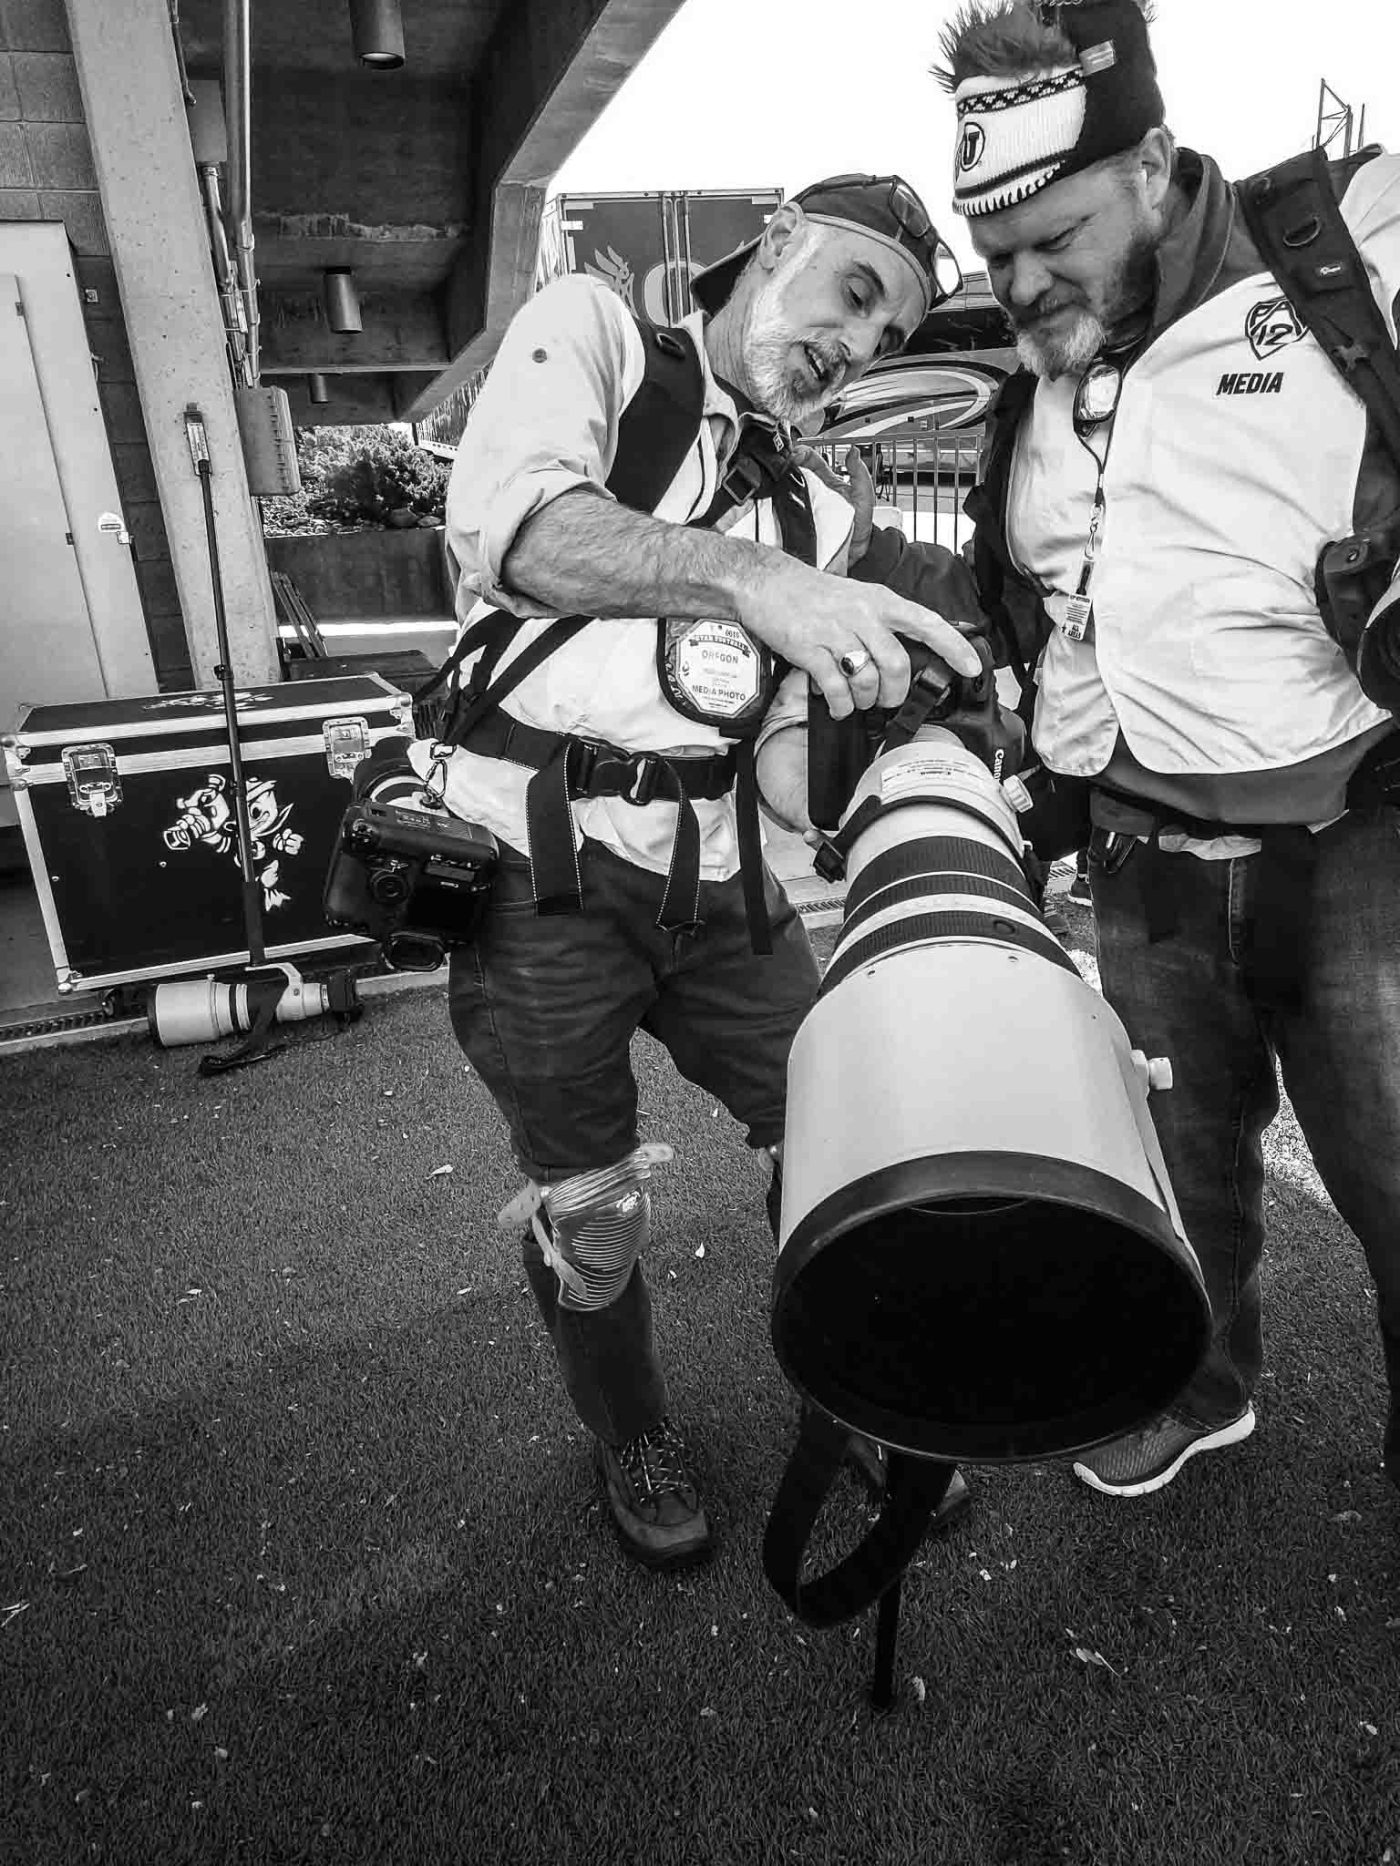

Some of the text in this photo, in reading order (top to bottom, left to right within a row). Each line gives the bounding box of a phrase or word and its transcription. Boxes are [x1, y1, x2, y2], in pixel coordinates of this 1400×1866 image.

[1256, 323, 1293, 346] 12
[1216, 371, 1284, 396] MEDIA
[692, 684, 746, 701] MEDIA PHOTO
[993, 748, 1005, 782] Cano
